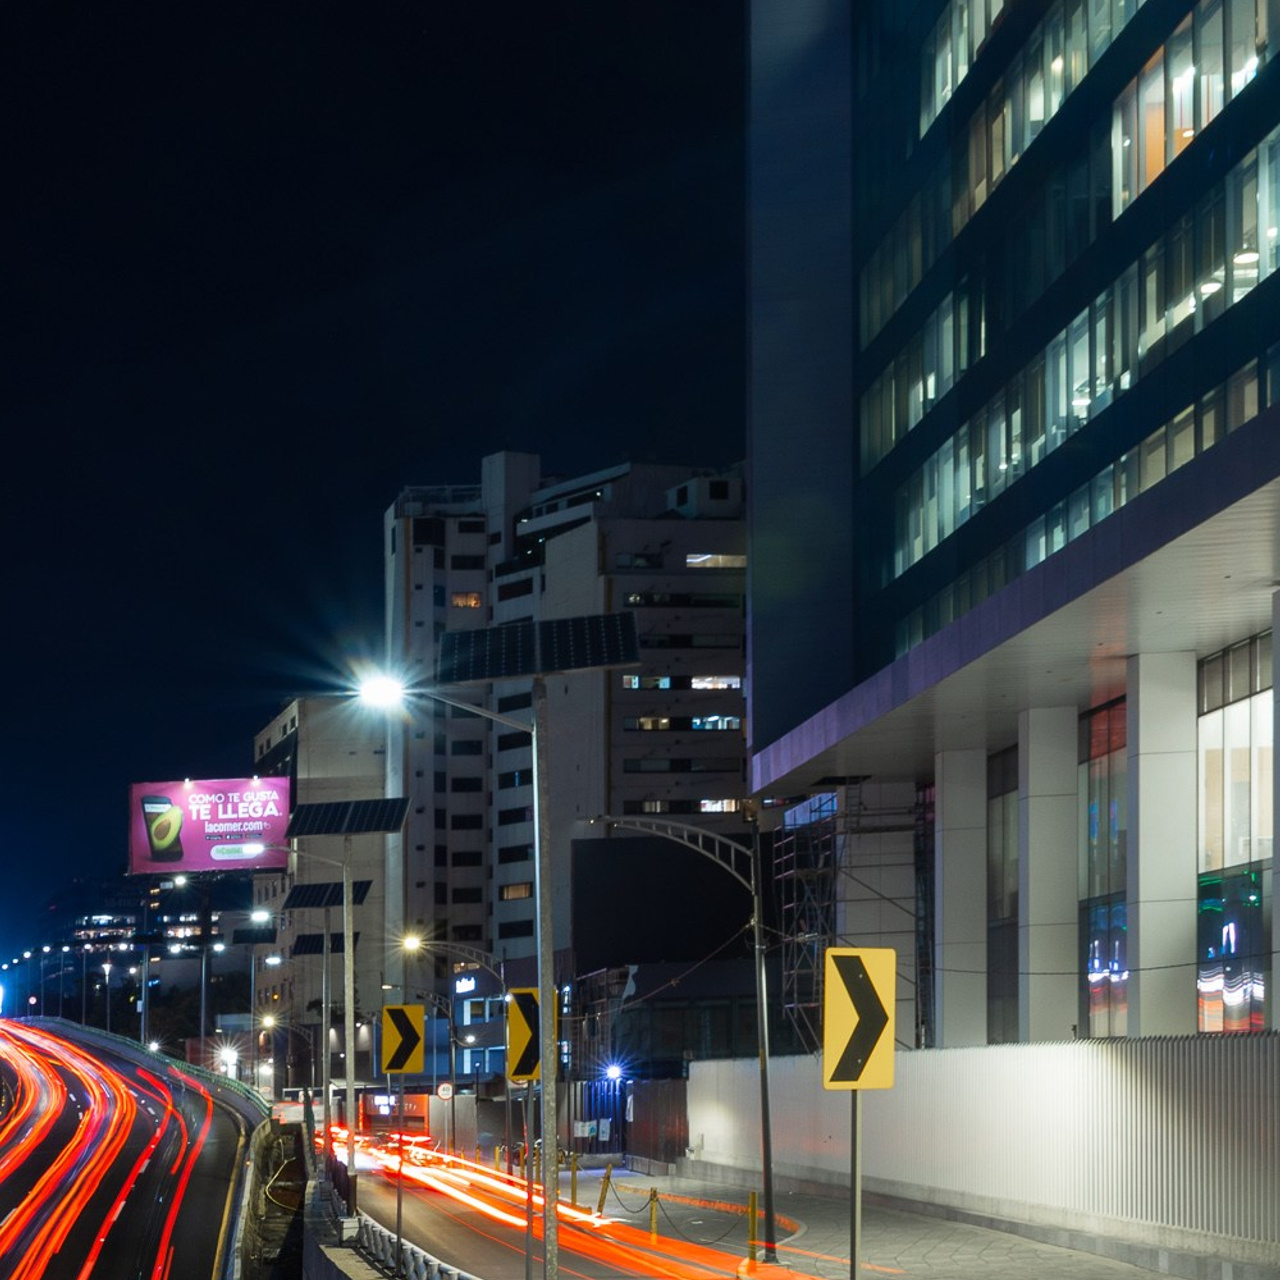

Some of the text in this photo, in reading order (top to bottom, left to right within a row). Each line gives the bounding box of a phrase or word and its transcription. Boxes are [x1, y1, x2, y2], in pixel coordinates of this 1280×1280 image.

[188, 791, 279, 803] COMO TE GUSTA
[188, 801, 282, 820] TE LLEGA.
[205, 821, 263, 833] lacomer.com
